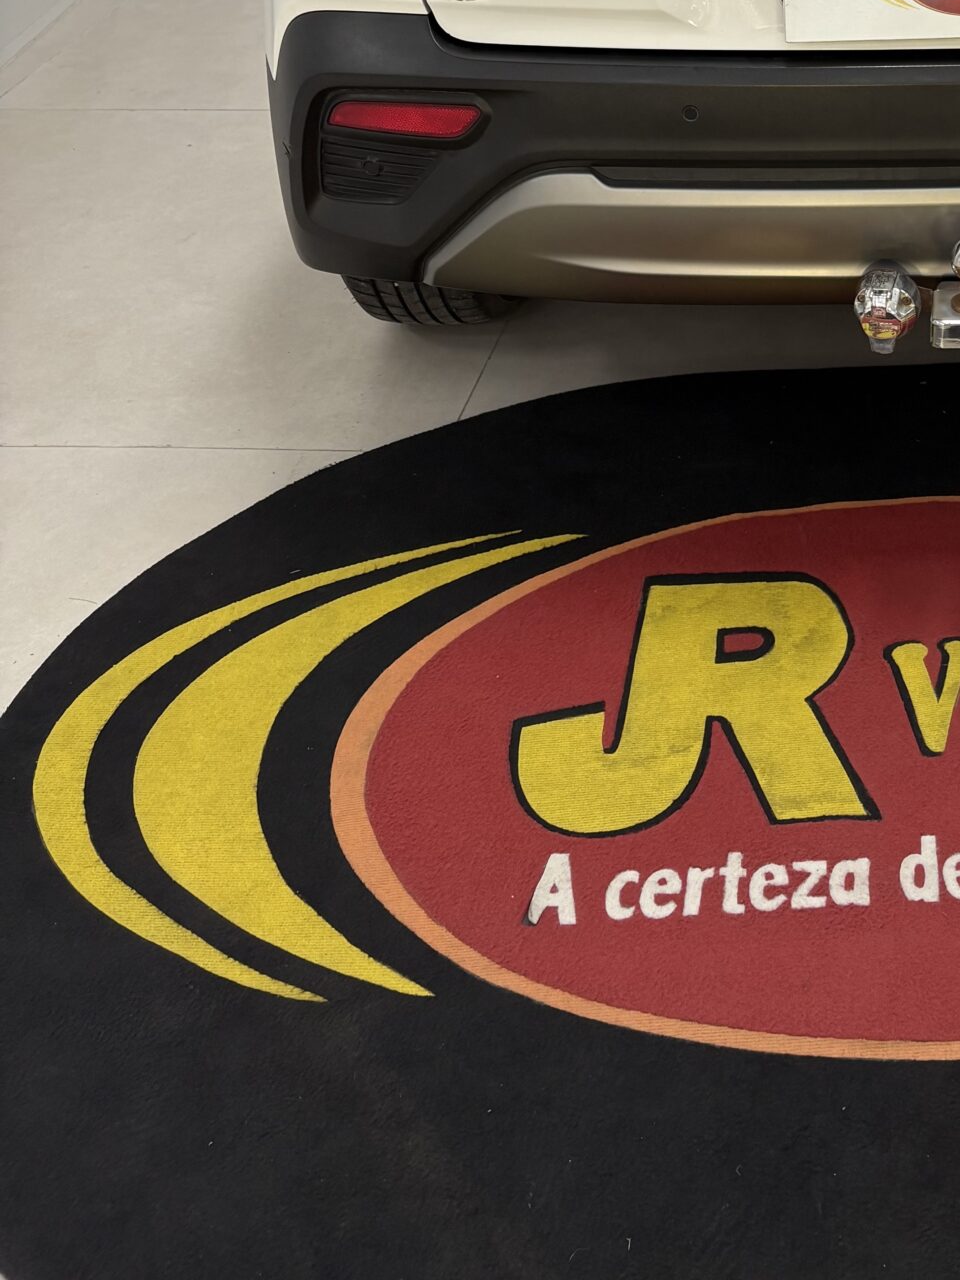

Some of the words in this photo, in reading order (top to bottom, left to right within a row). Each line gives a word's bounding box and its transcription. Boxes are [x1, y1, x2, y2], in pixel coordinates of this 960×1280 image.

[510, 572, 881, 837] JR
[526, 852, 577, 926] A
[604, 850, 871, 921] certeza
